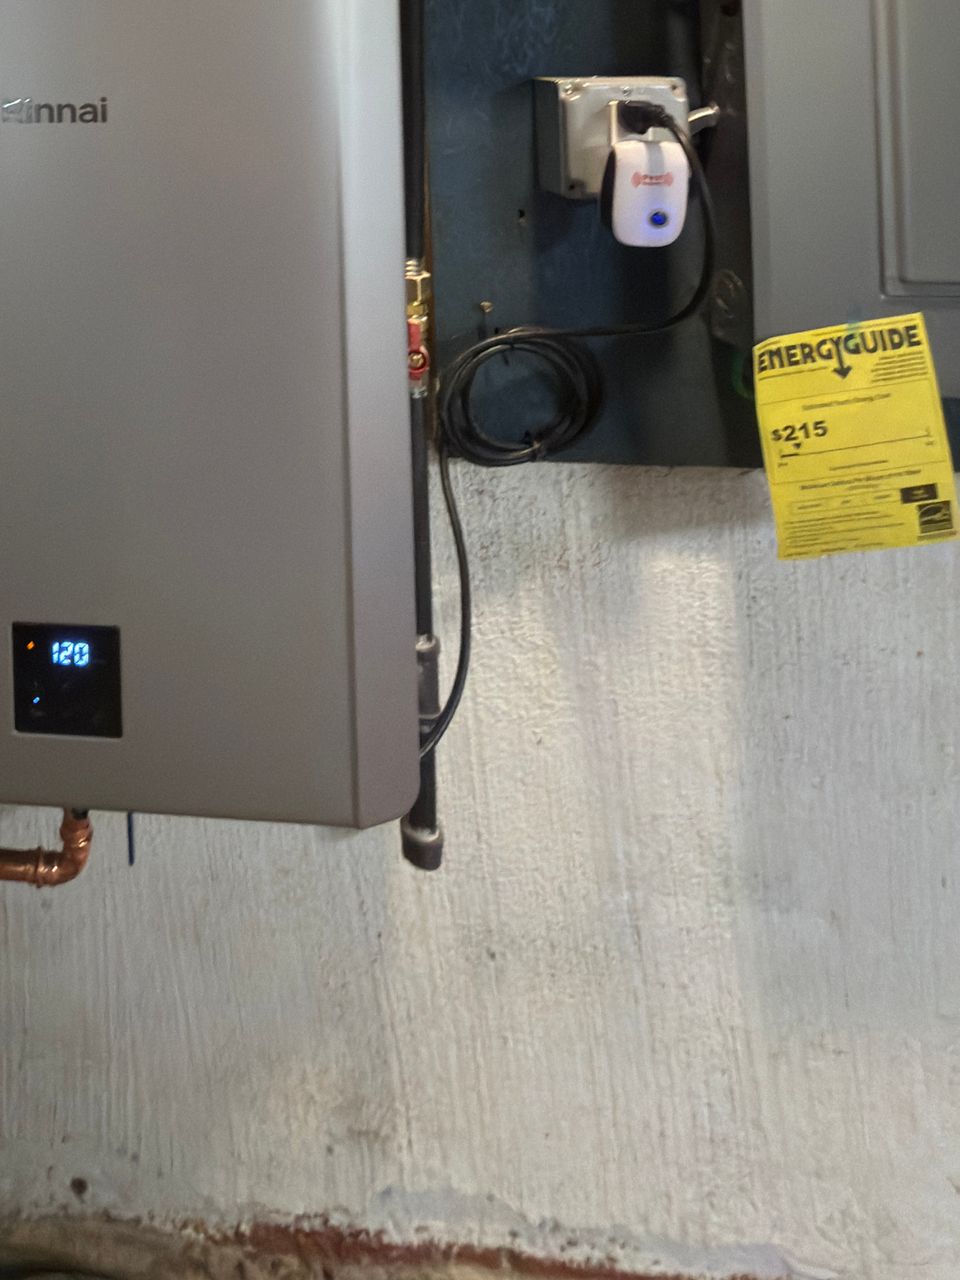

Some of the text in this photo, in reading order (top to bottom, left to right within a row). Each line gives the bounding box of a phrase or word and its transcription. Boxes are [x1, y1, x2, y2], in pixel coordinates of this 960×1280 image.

[1, 96, 109, 125] Rinnai
[771, 420, 828, 443] $215
[51, 640, 90, 667] 120
